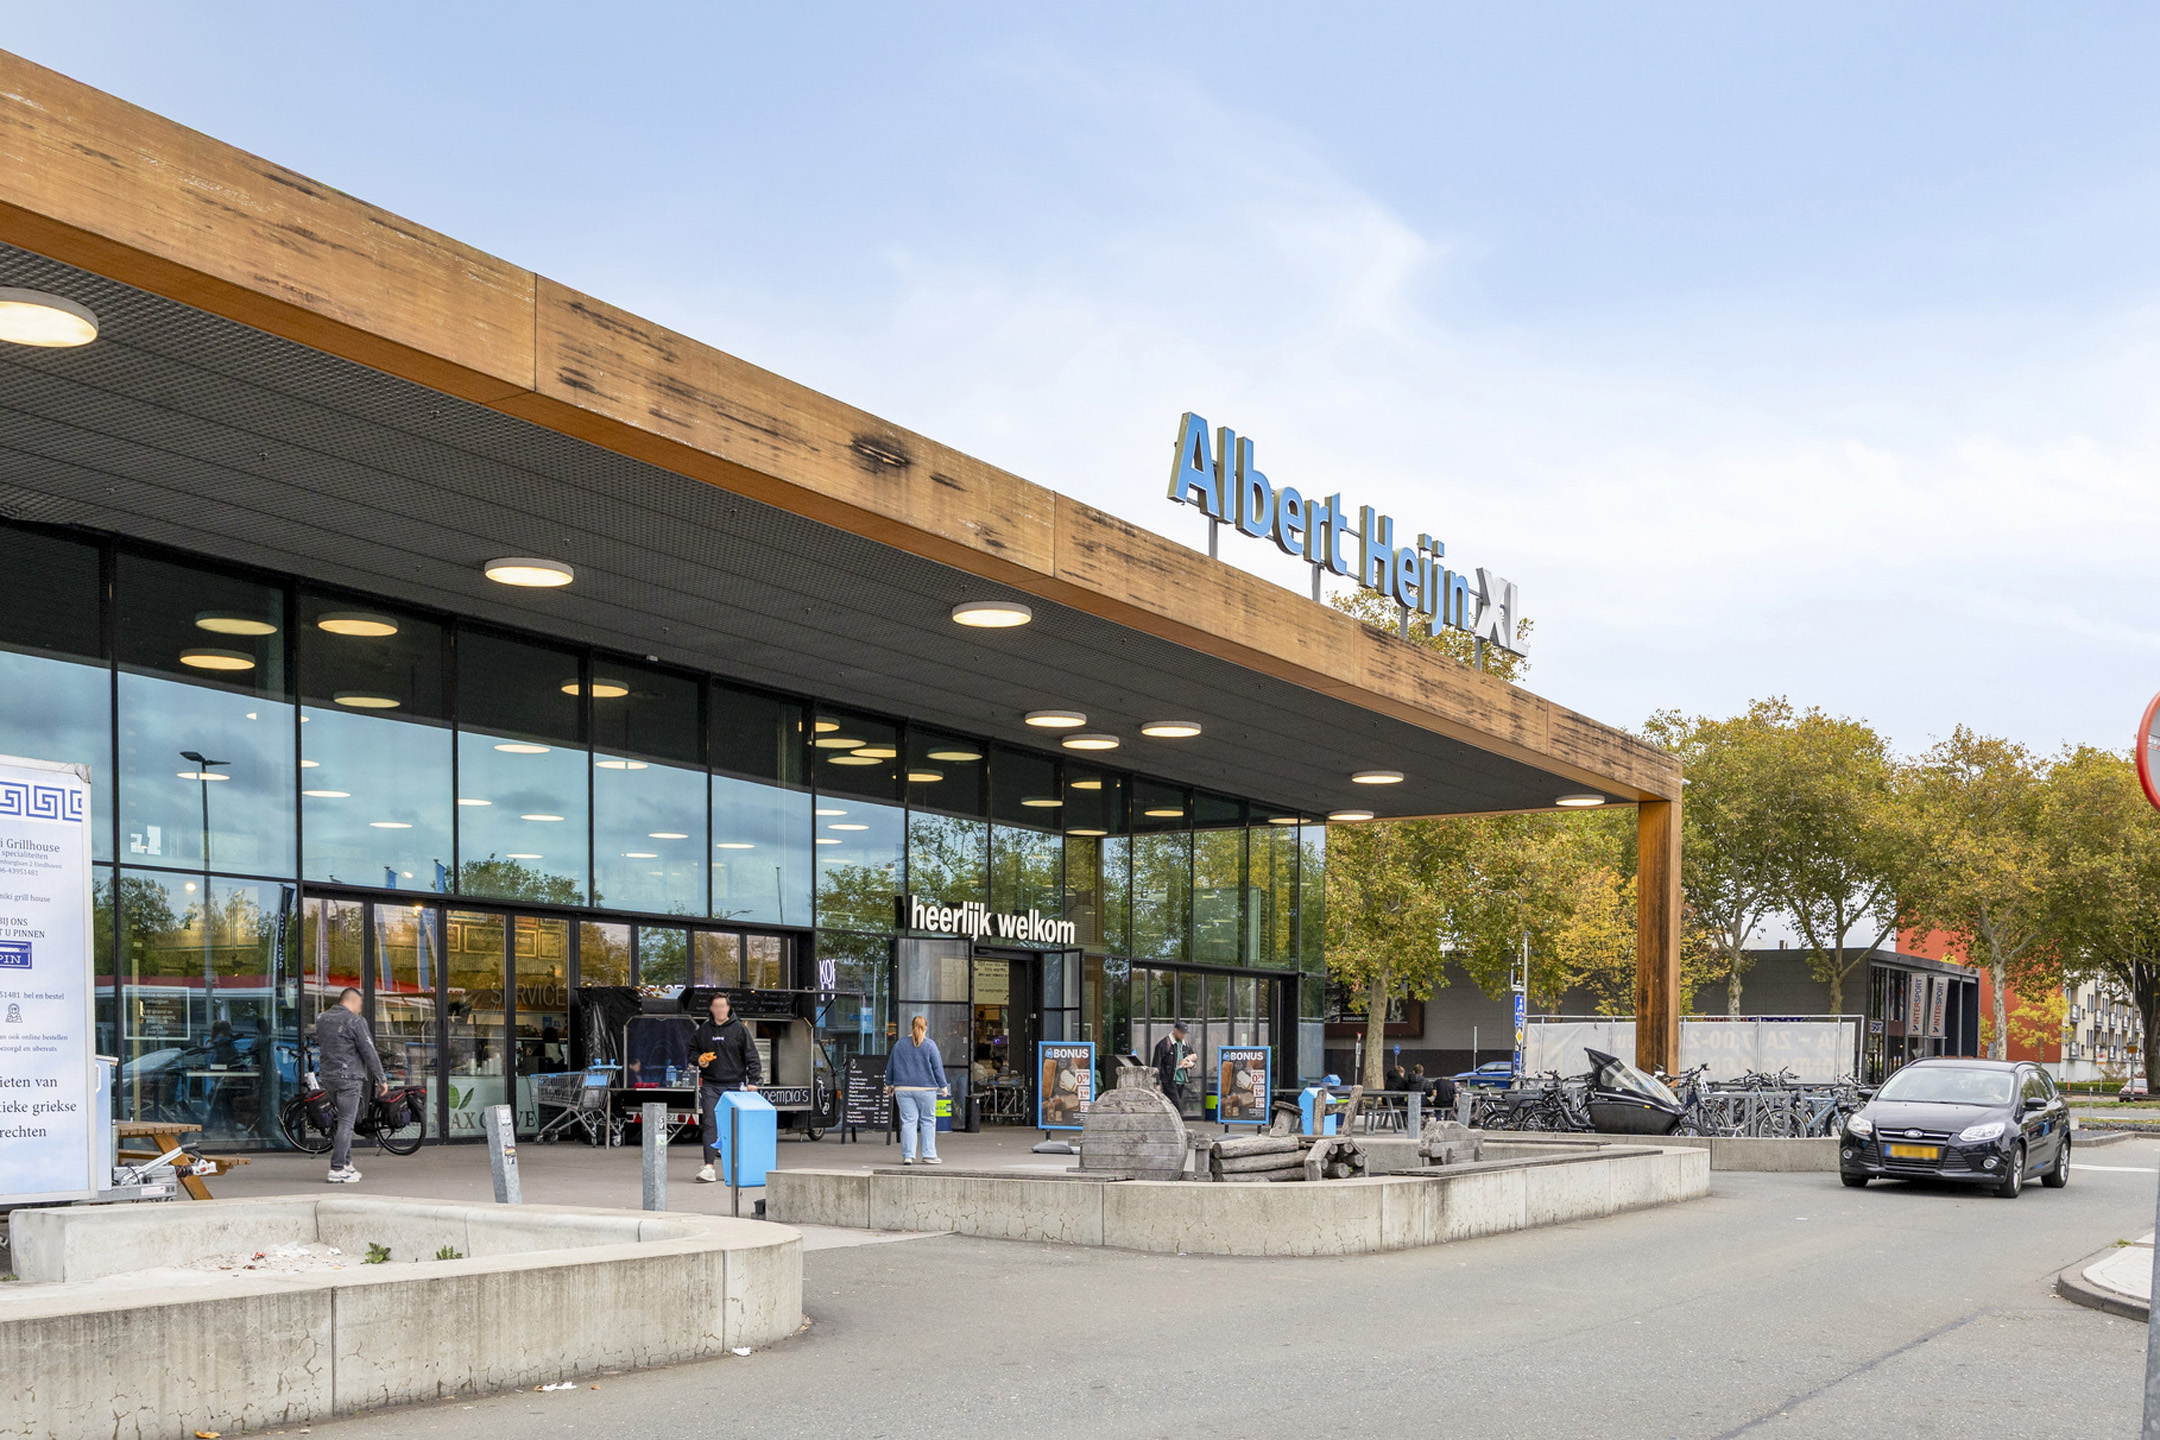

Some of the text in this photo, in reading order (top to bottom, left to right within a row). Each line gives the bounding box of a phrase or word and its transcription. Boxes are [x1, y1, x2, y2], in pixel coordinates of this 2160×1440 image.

[1167, 411, 1529, 658] Albert Heijn XL
[6, 838, 60, 853] Grillhouse
[14, 894, 29, 902] grill
[30, 894, 52, 903] house
[11, 917, 28, 927] ONS
[911, 894, 1075, 945] heerlijk welkom
[5, 929, 11, 937] U
[13, 929, 45, 938] PINNEN
[23, 991, 34, 999] bel
[45, 992, 65, 1000] bestel
[490, 982, 566, 1006] SRVICE
[1913, 978, 1922, 1024] INTERSPORT
[1933, 982, 1944, 1026] INTERSPORT
[42, 1033, 68, 1041] bestellen
[1053, 1048, 1089, 1059] BONUS
[1230, 1051, 1264, 1061] BONUS
[35, 1078, 58, 1088] van
[0, 1099, 77, 1117] ieke griekse
[0, 1124, 47, 1138] rechten
